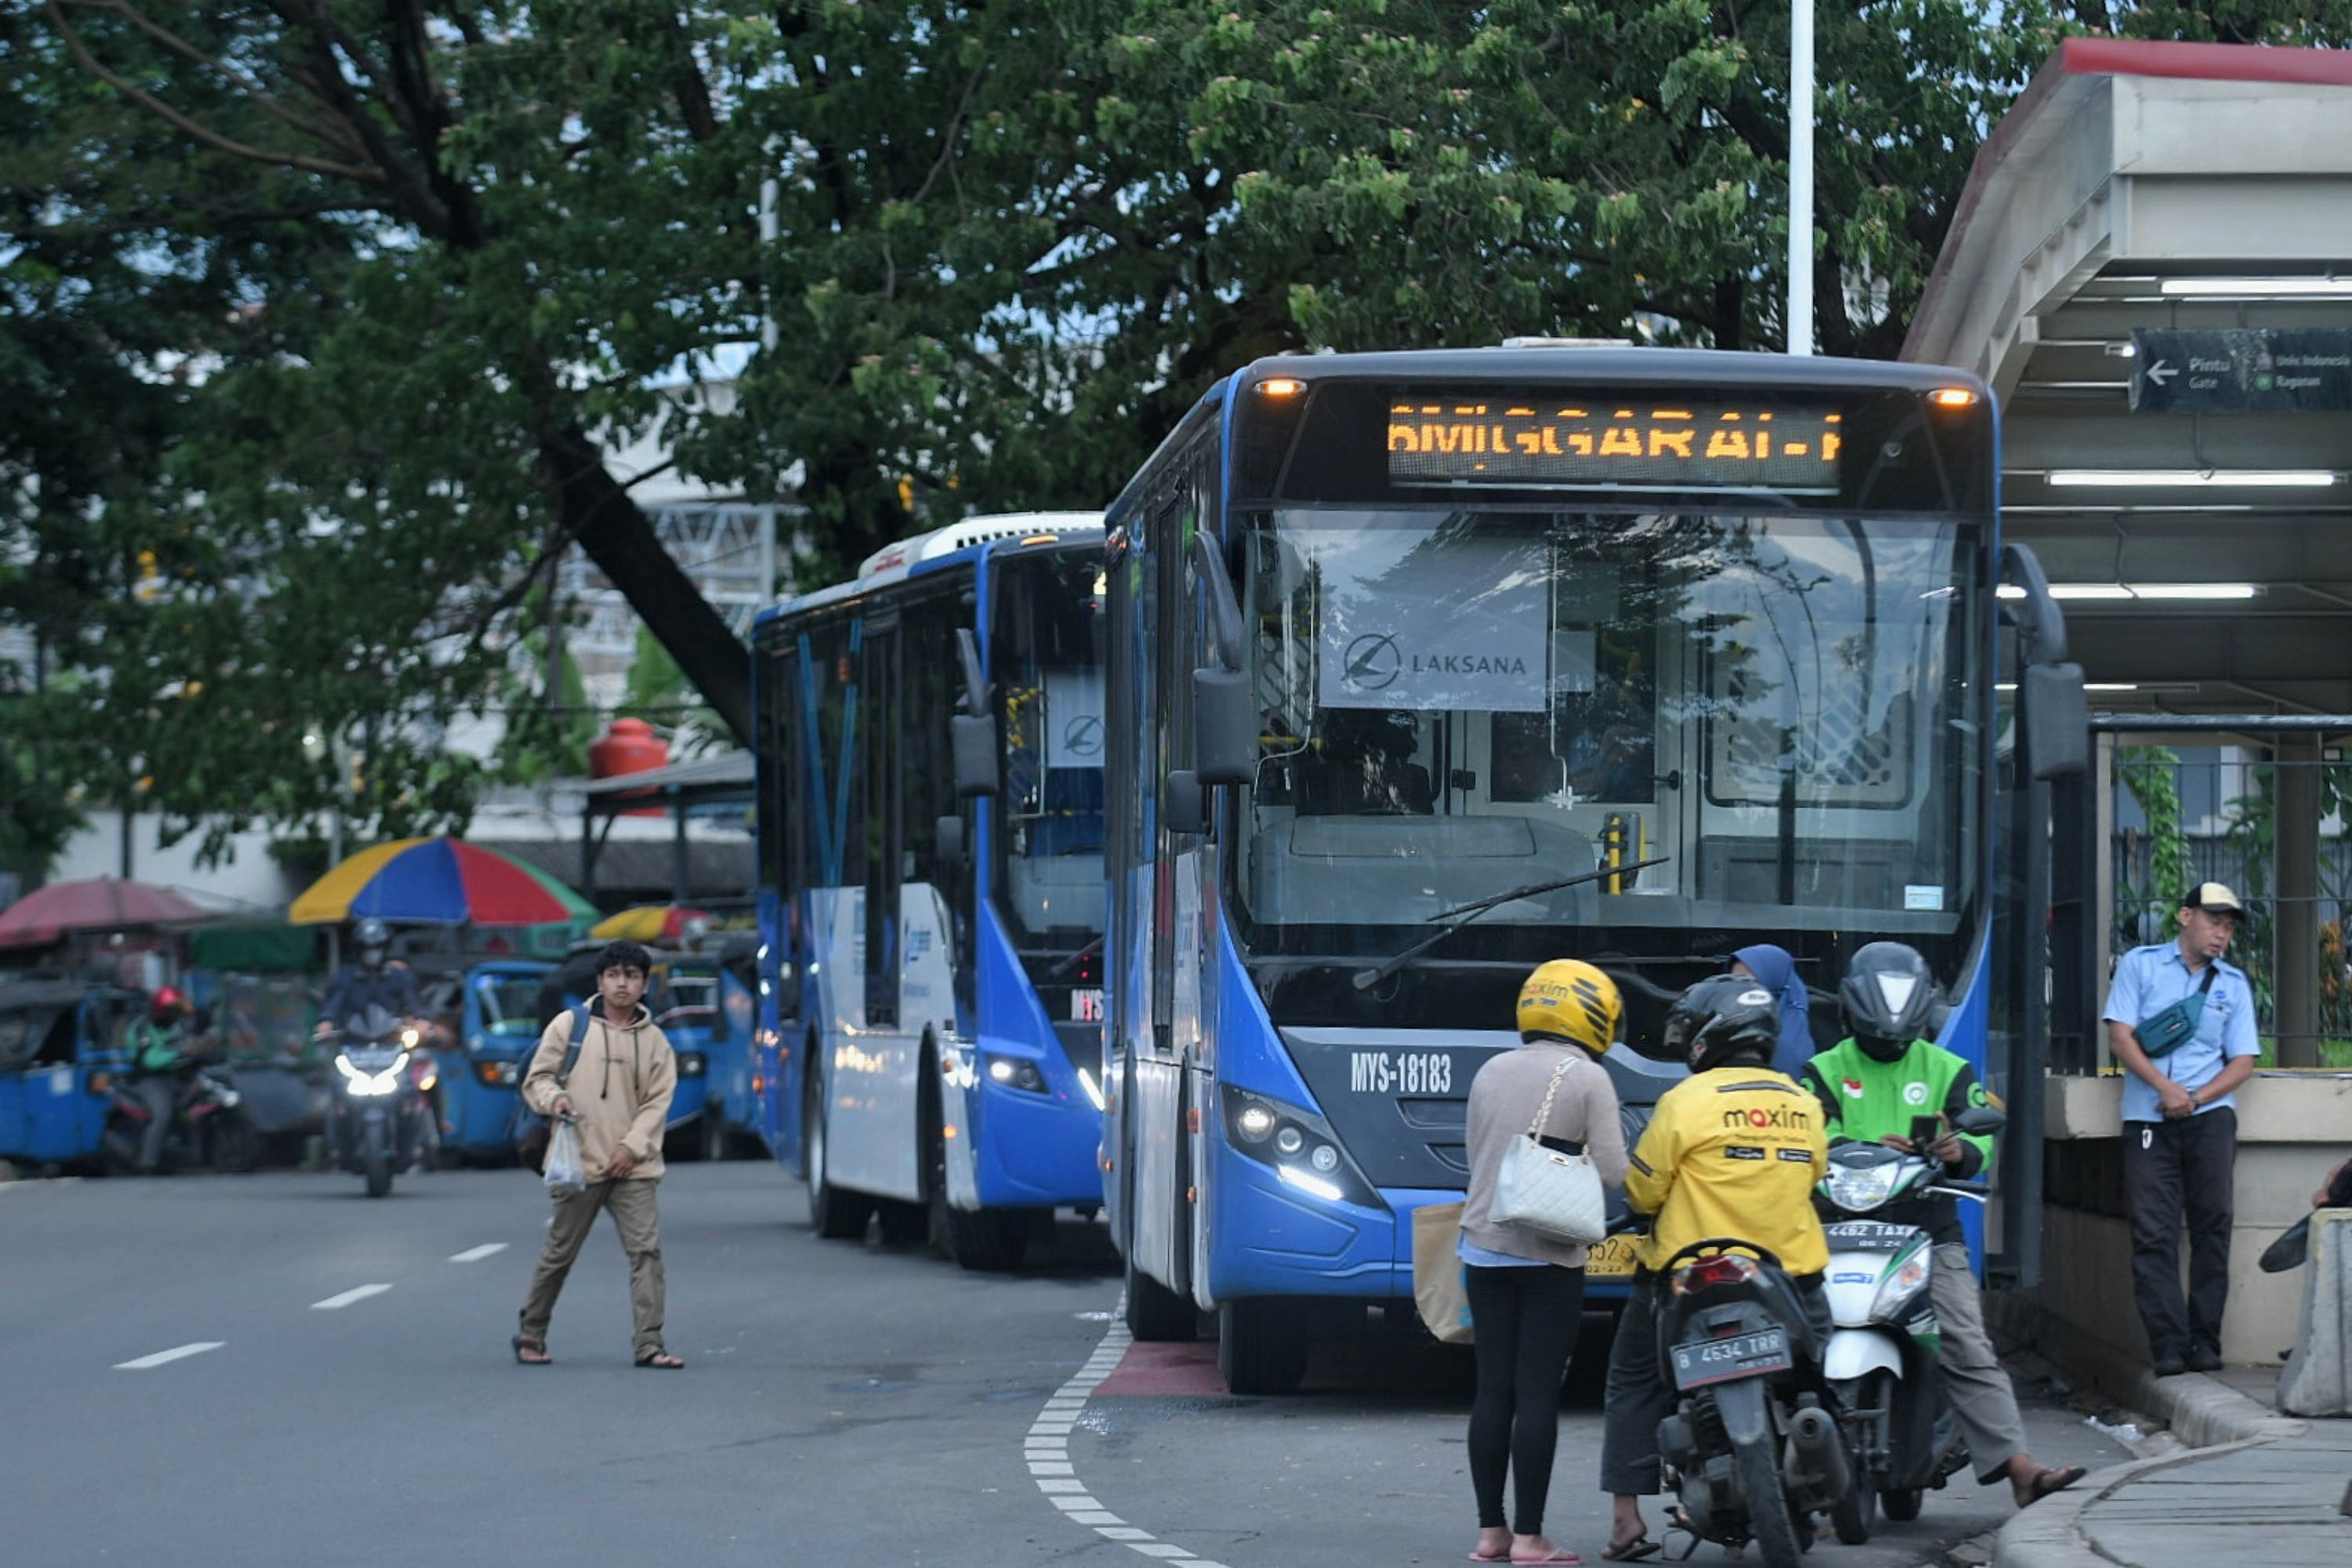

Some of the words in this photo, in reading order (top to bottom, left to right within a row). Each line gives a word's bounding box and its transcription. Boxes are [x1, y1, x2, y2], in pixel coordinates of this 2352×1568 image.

[1413, 653, 1526, 675] LAKSANA
[1351, 1052, 1451, 1093] MYS-18183
[1723, 1104, 1811, 1131] maxim
[1679, 1352, 1691, 1370] B
[1701, 1341, 1744, 1363] 4634
[1748, 1334, 1780, 1354] TRR
